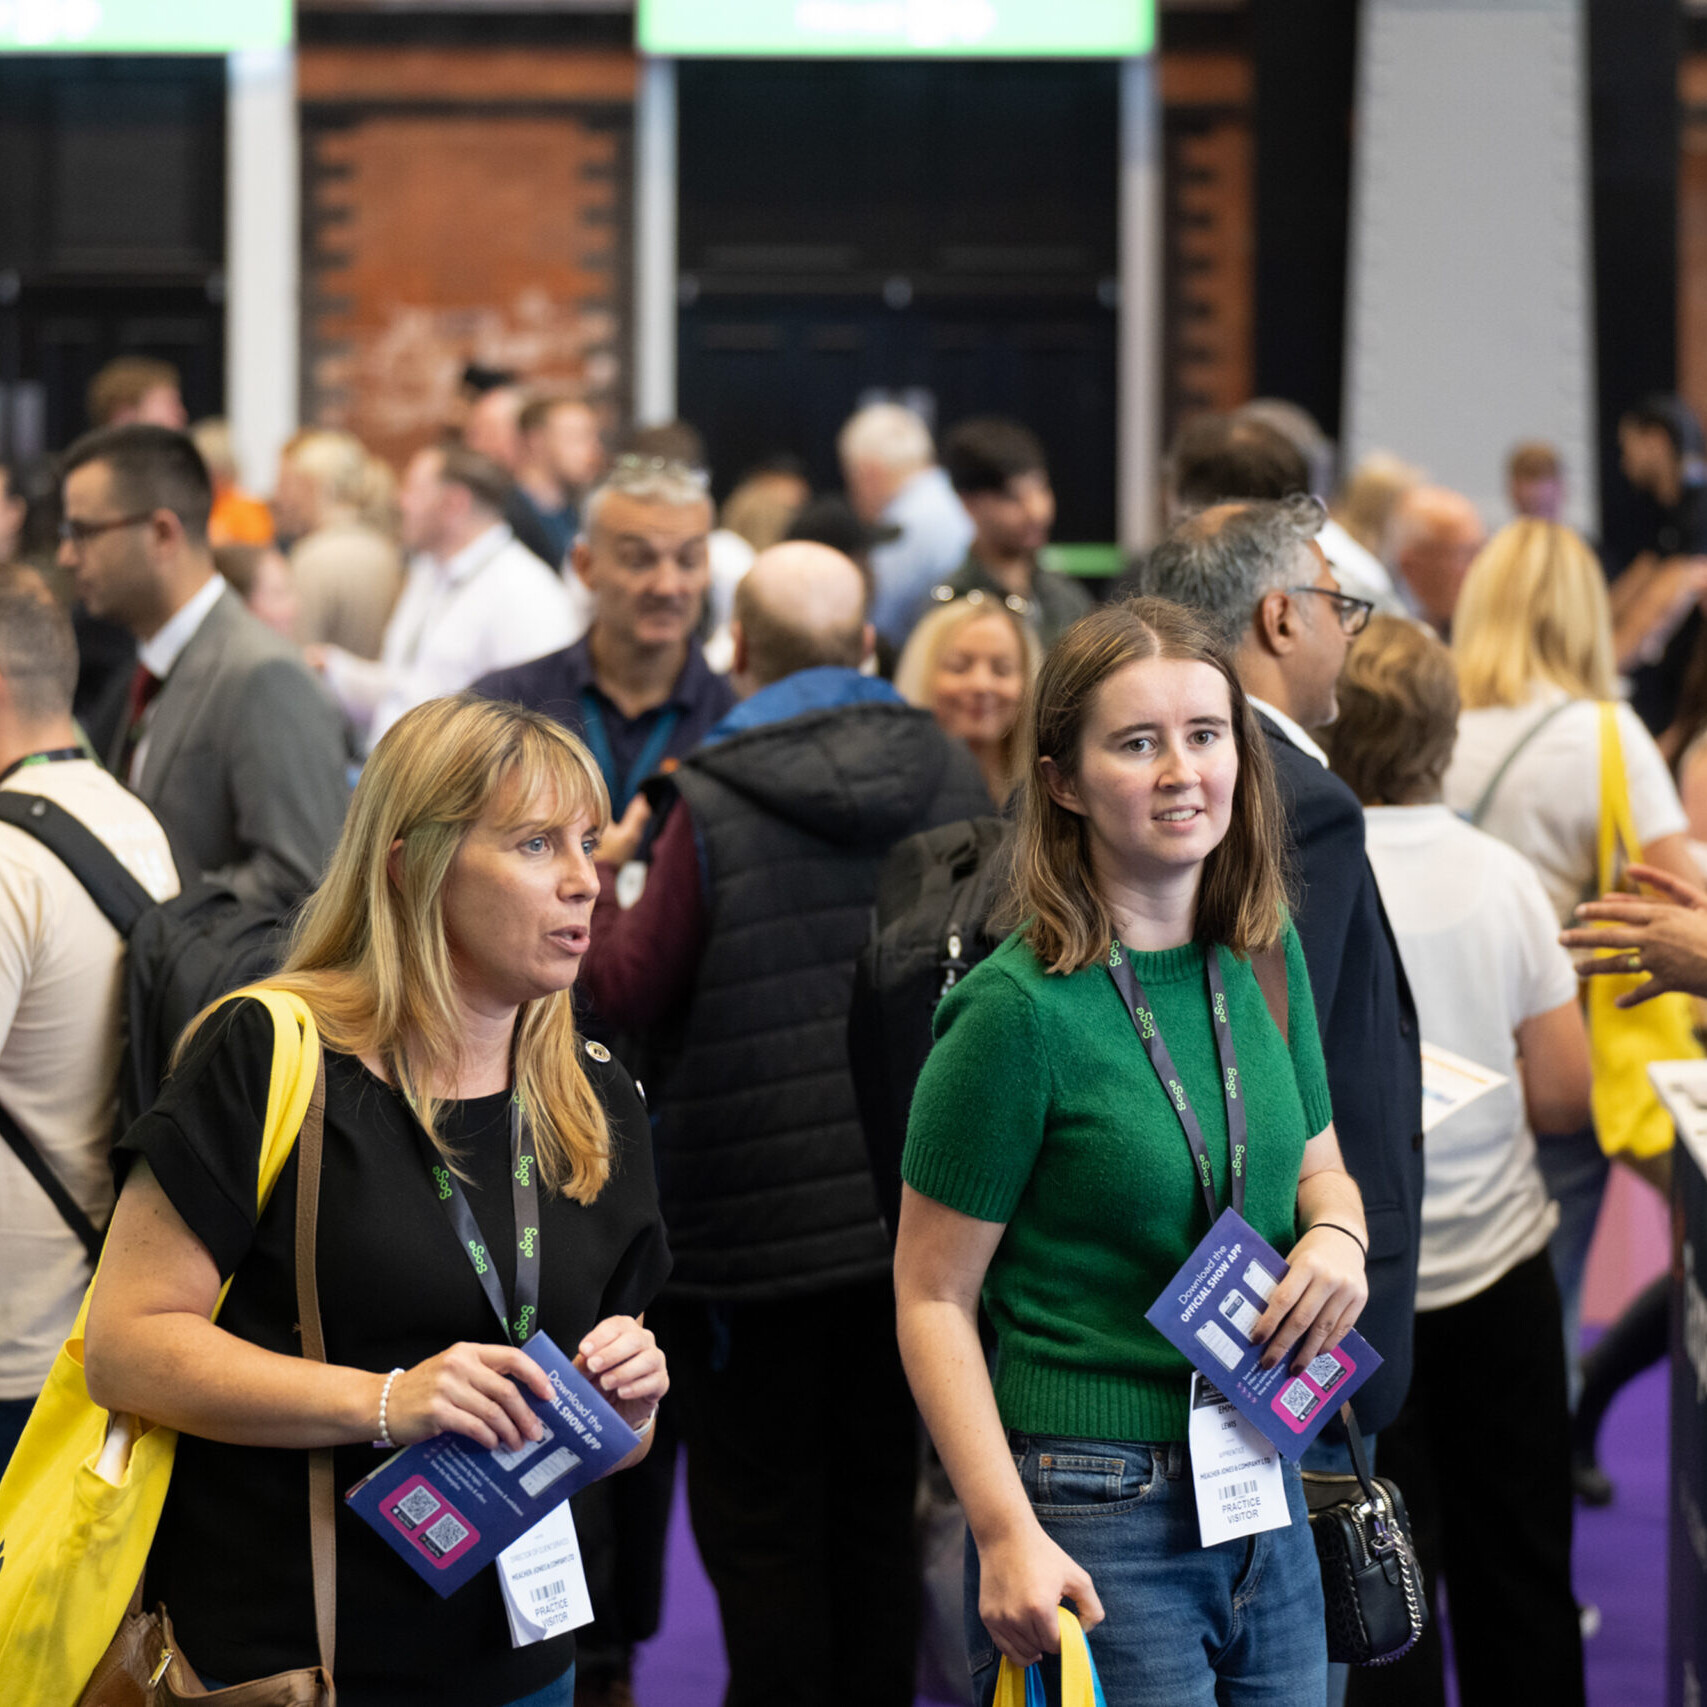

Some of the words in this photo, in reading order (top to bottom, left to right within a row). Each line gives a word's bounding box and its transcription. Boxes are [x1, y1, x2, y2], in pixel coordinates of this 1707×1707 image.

[1109, 939, 1122, 967] Sag
[1178, 1257, 1215, 1304] Download
[1212, 1245, 1227, 1261] the
[1180, 1286, 1212, 1322] OFFICIAL
[1207, 1260, 1230, 1289] SHOW
[1227, 1243, 1242, 1263] APP
[548, 1369, 592, 1417] Download
[587, 1415, 602, 1432] the
[559, 1406, 587, 1434] SHOW
[582, 1432, 602, 1449] APP
[1221, 1420, 1236, 1430] LEWIS
[1222, 1497, 1261, 1514] PRACTICE
[1227, 1509, 1259, 1524] VISITOR
[534, 1598, 568, 1617] PRACTICE
